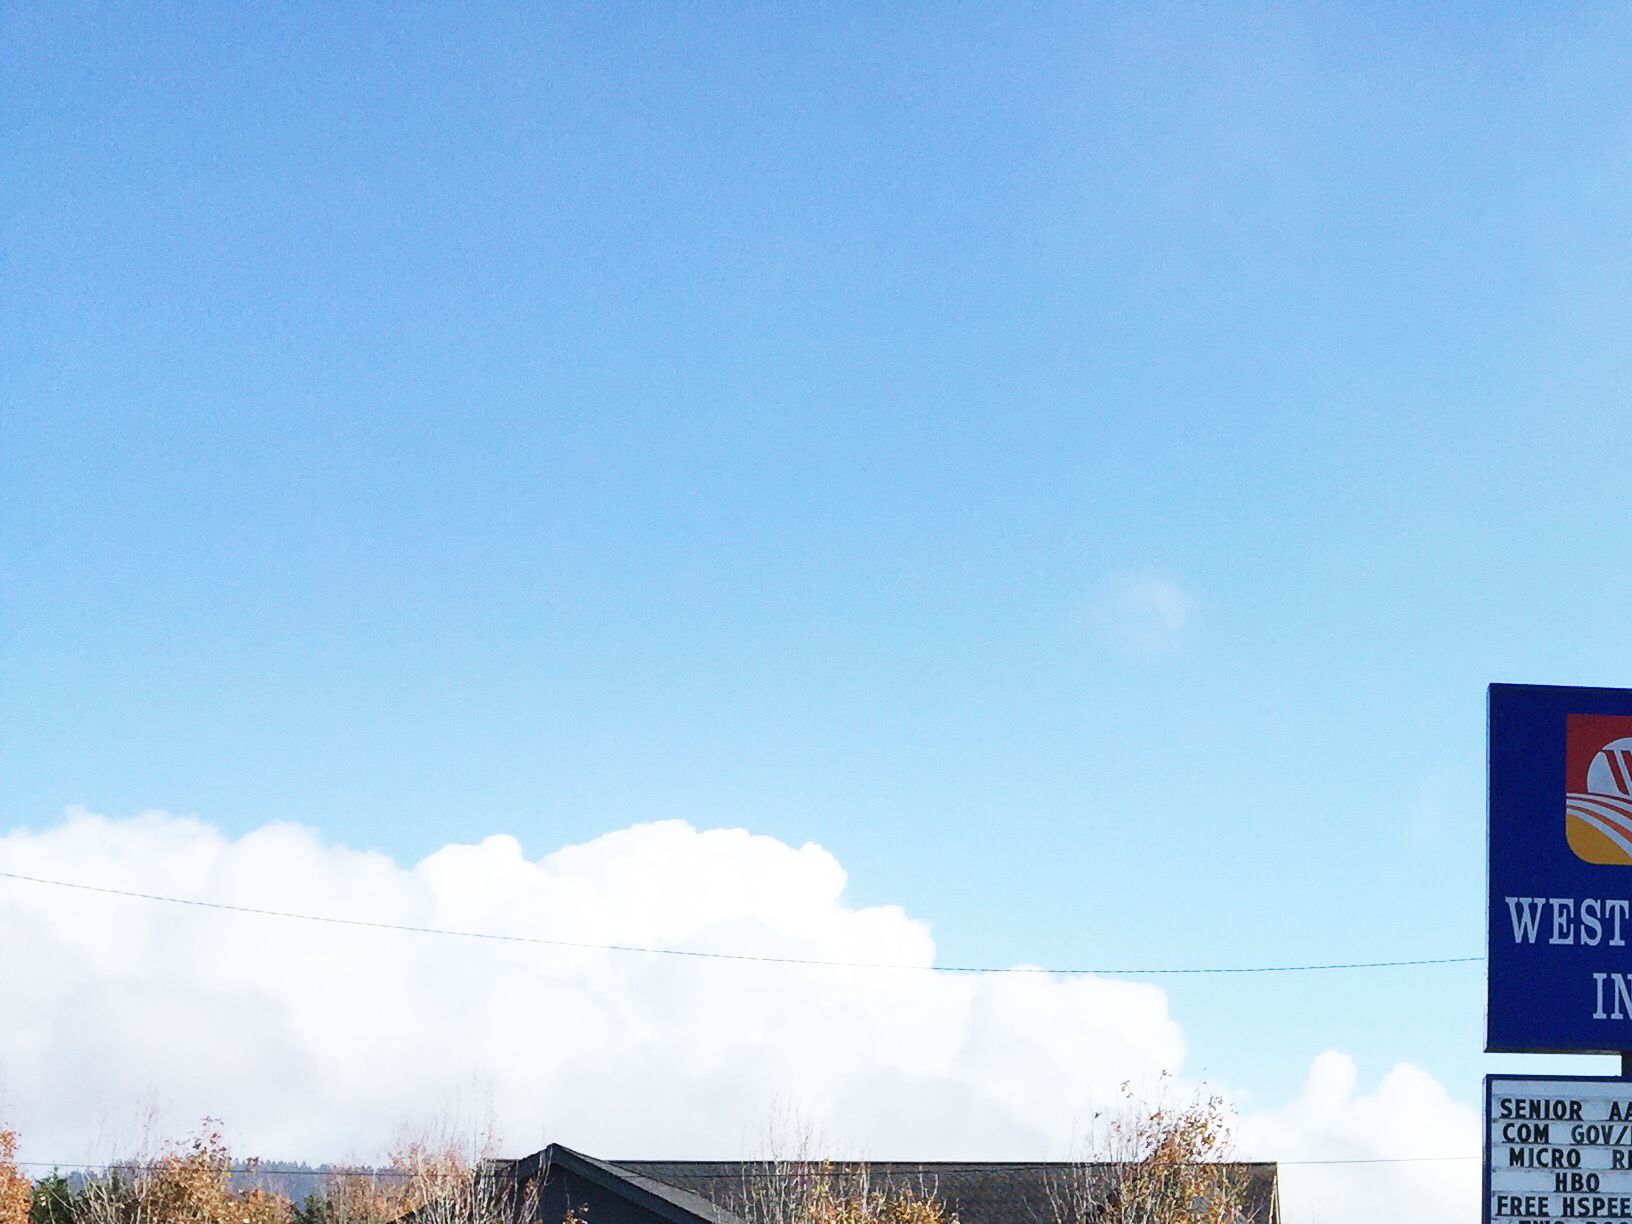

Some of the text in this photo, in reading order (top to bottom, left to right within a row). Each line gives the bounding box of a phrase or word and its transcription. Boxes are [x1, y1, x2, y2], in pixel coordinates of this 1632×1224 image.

[1500, 1099, 1582, 1120] SENIOR
[1502, 1123, 1550, 1144] COM
[1509, 1148, 1581, 1168] MICRO
[1554, 1172, 1600, 1192] HBO
[1496, 1196, 1549, 1216] FREE
